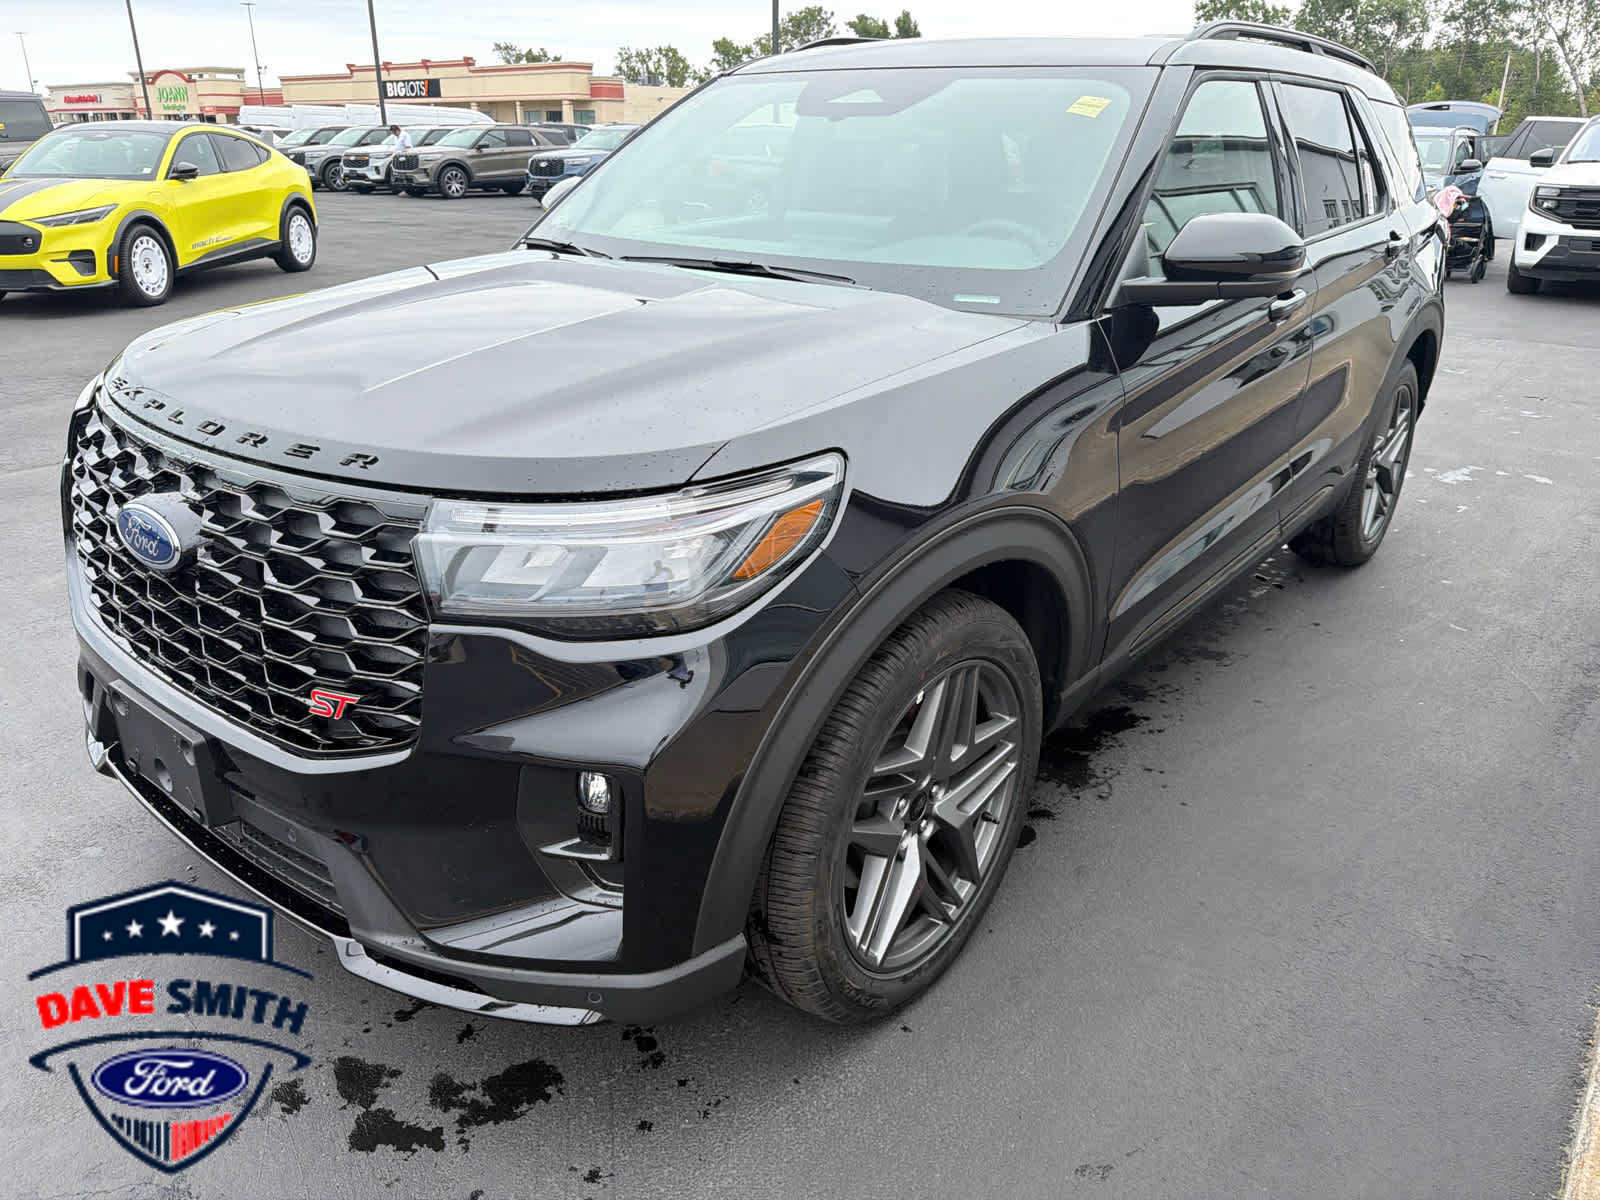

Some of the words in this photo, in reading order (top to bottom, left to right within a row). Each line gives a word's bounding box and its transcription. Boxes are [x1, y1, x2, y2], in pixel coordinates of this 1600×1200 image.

[157, 88, 189, 102] JOANN
[111, 376, 380, 469] EXPLORER
[125, 515, 160, 556] Ford
[309, 688, 360, 719] ST
